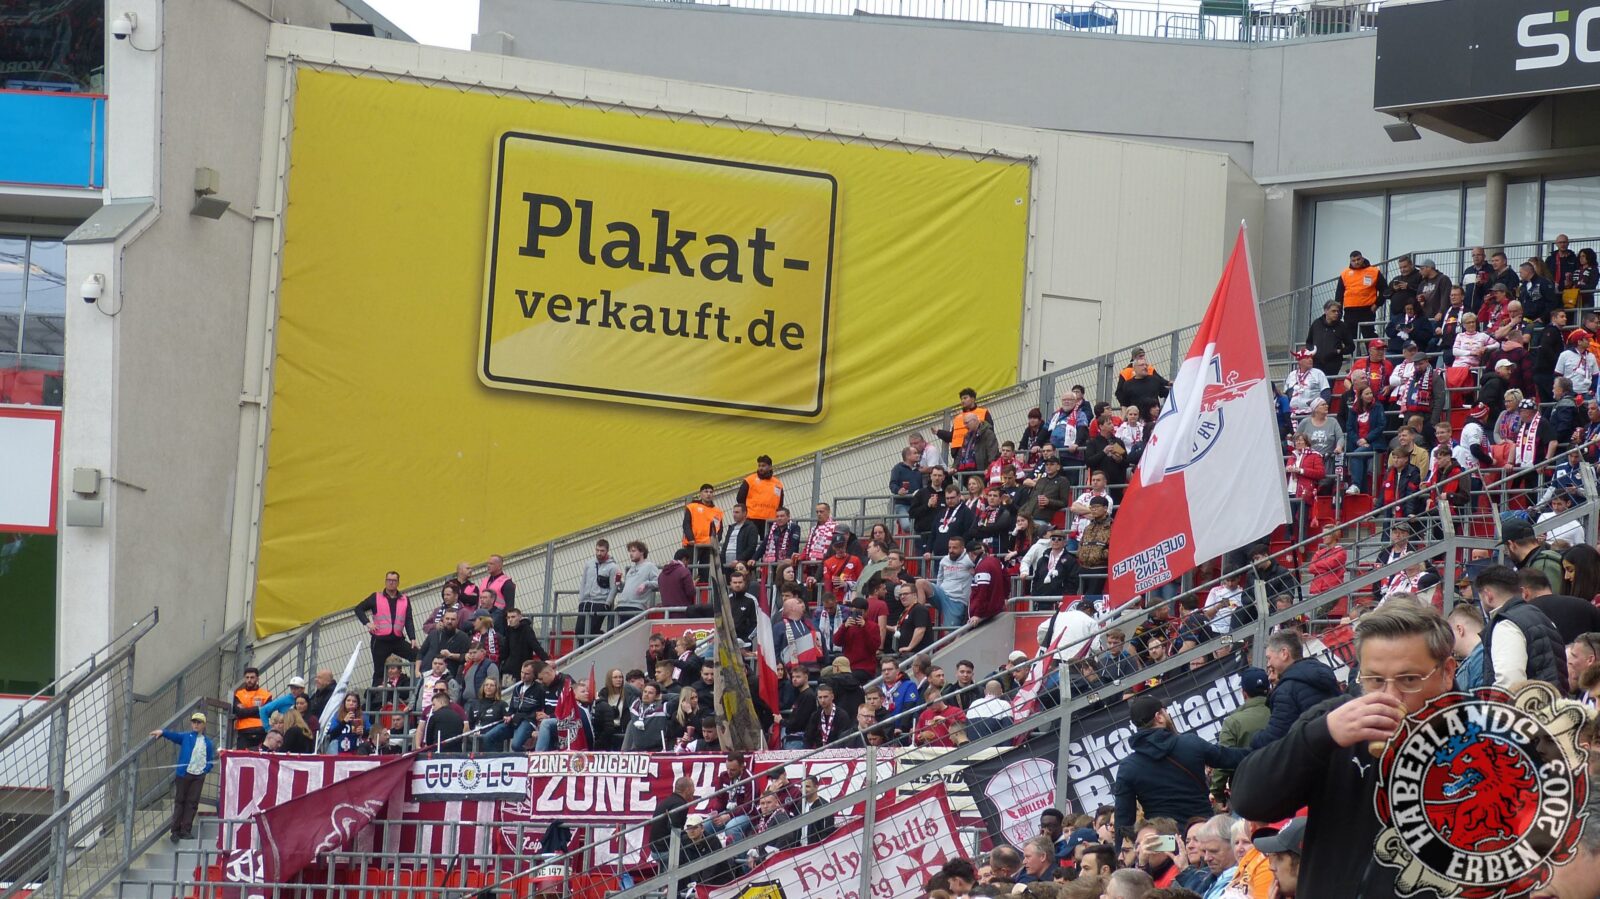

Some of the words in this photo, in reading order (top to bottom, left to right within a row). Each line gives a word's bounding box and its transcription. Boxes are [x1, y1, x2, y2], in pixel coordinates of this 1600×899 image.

[518, 192, 810, 287] Plakat-
[515, 289, 805, 351] verkauft.de
[530, 755, 569, 773] ZONE
[588, 755, 650, 774] JUGEND
[536, 762, 659, 812] ZONE
[793, 851, 860, 892] Holy
[873, 816, 939, 861] Bulls
